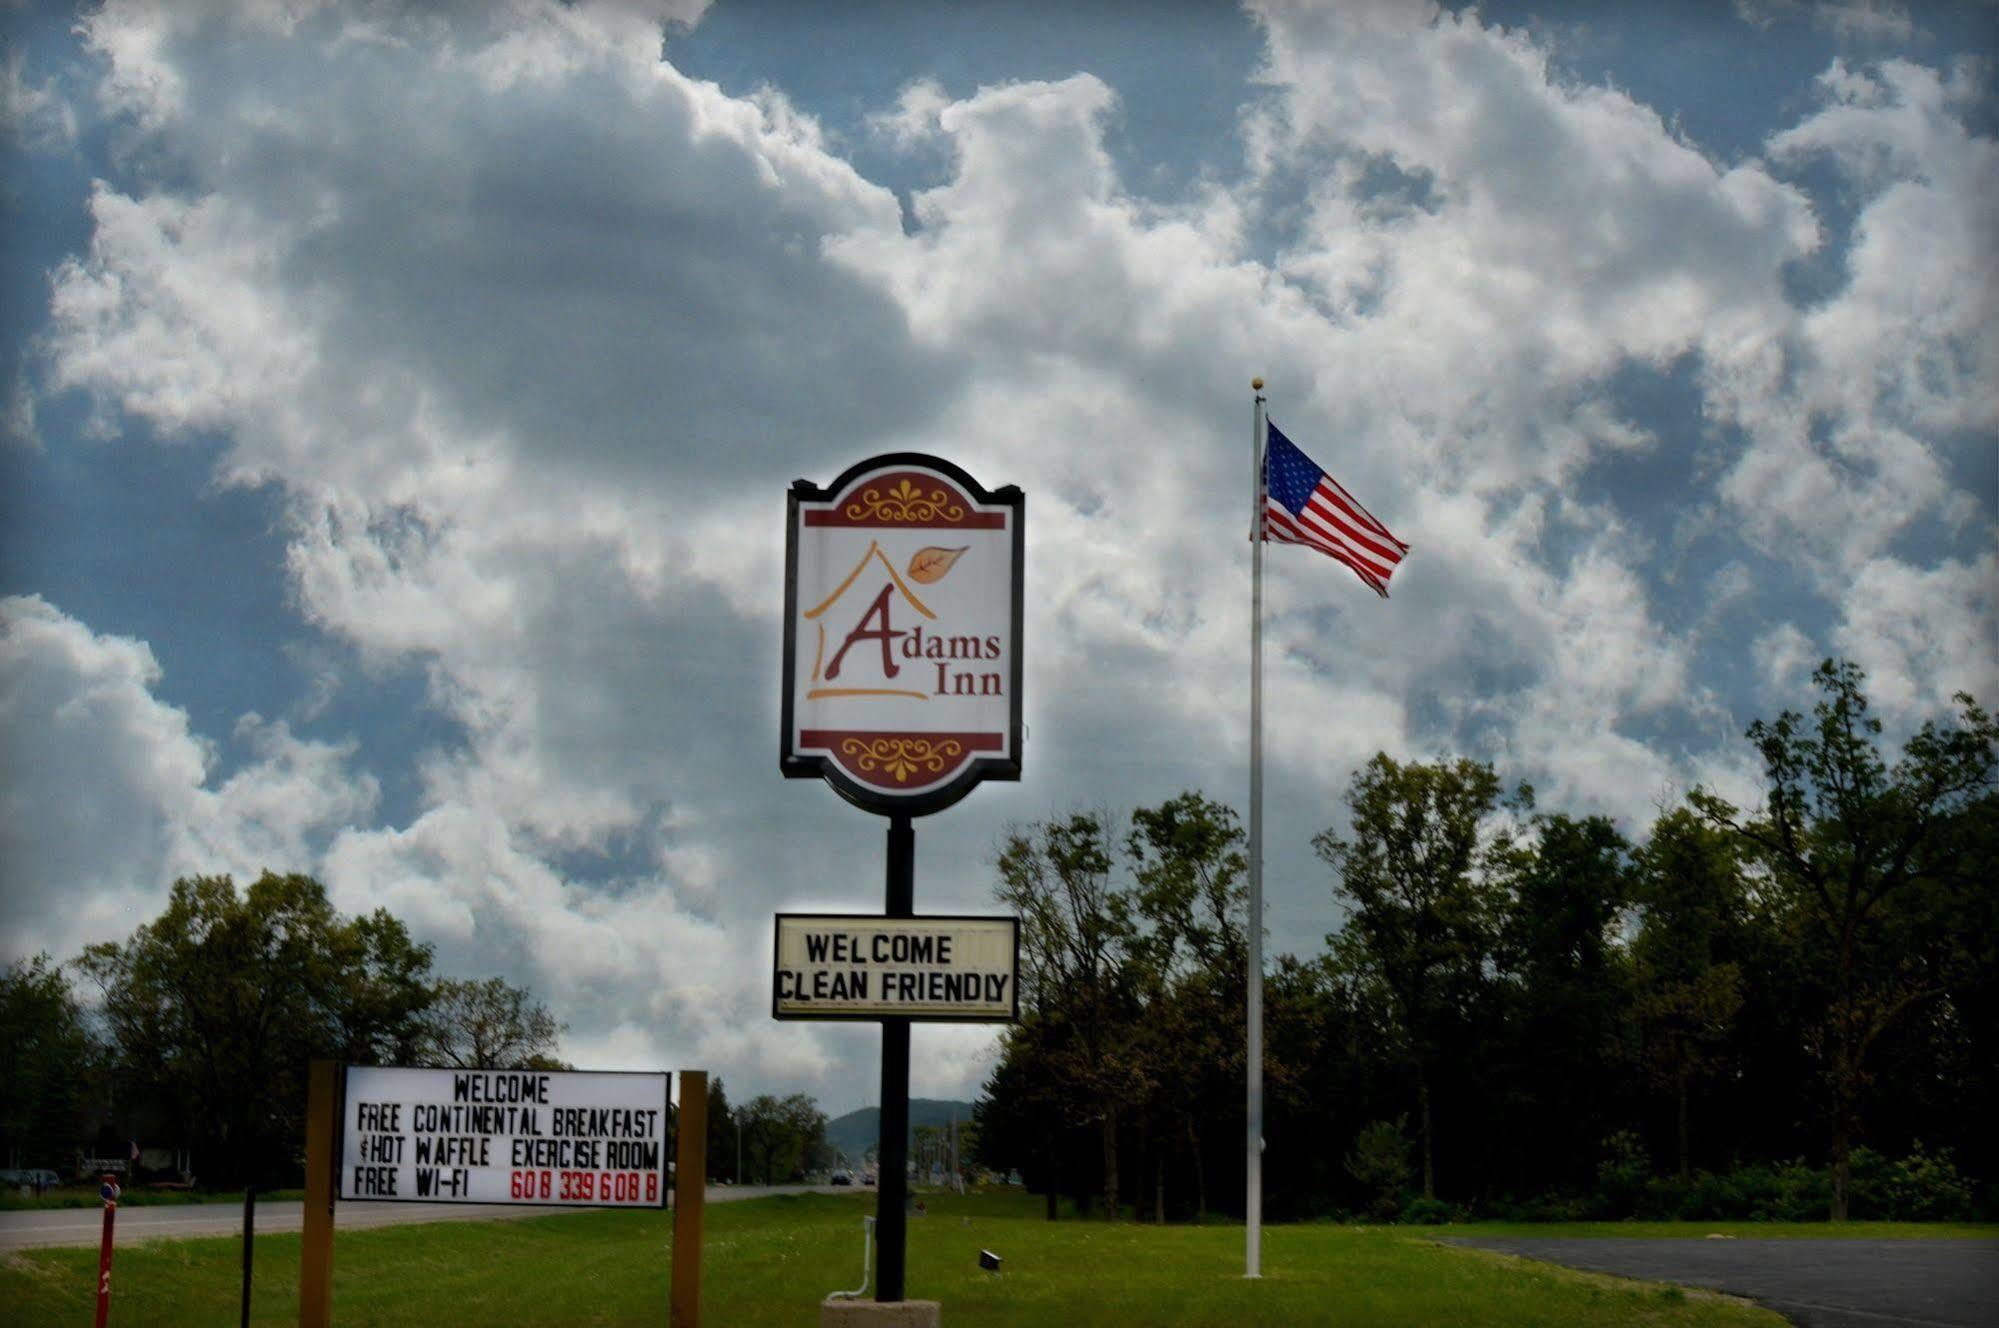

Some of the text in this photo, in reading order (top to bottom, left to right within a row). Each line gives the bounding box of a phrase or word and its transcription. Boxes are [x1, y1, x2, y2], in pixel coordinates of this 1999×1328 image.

[824, 582, 1001, 681] Adams
[934, 662, 1004, 696] Inn
[806, 934, 952, 963] WELCOME
[776, 970, 868, 1000] CLEAN
[454, 1074, 550, 1104] WELCOME
[358, 1102, 657, 1139] FREE CONTINENTAL BREAKFAST
[416, 1137, 490, 1166] WAFFLE
[512, 1139, 602, 1169] EXERCISE
[607, 1141, 659, 1170] ROOM
[354, 1166, 398, 1196] FREE
[416, 1167, 469, 1198] WI-FI
[559, 1171, 594, 1201] 339
